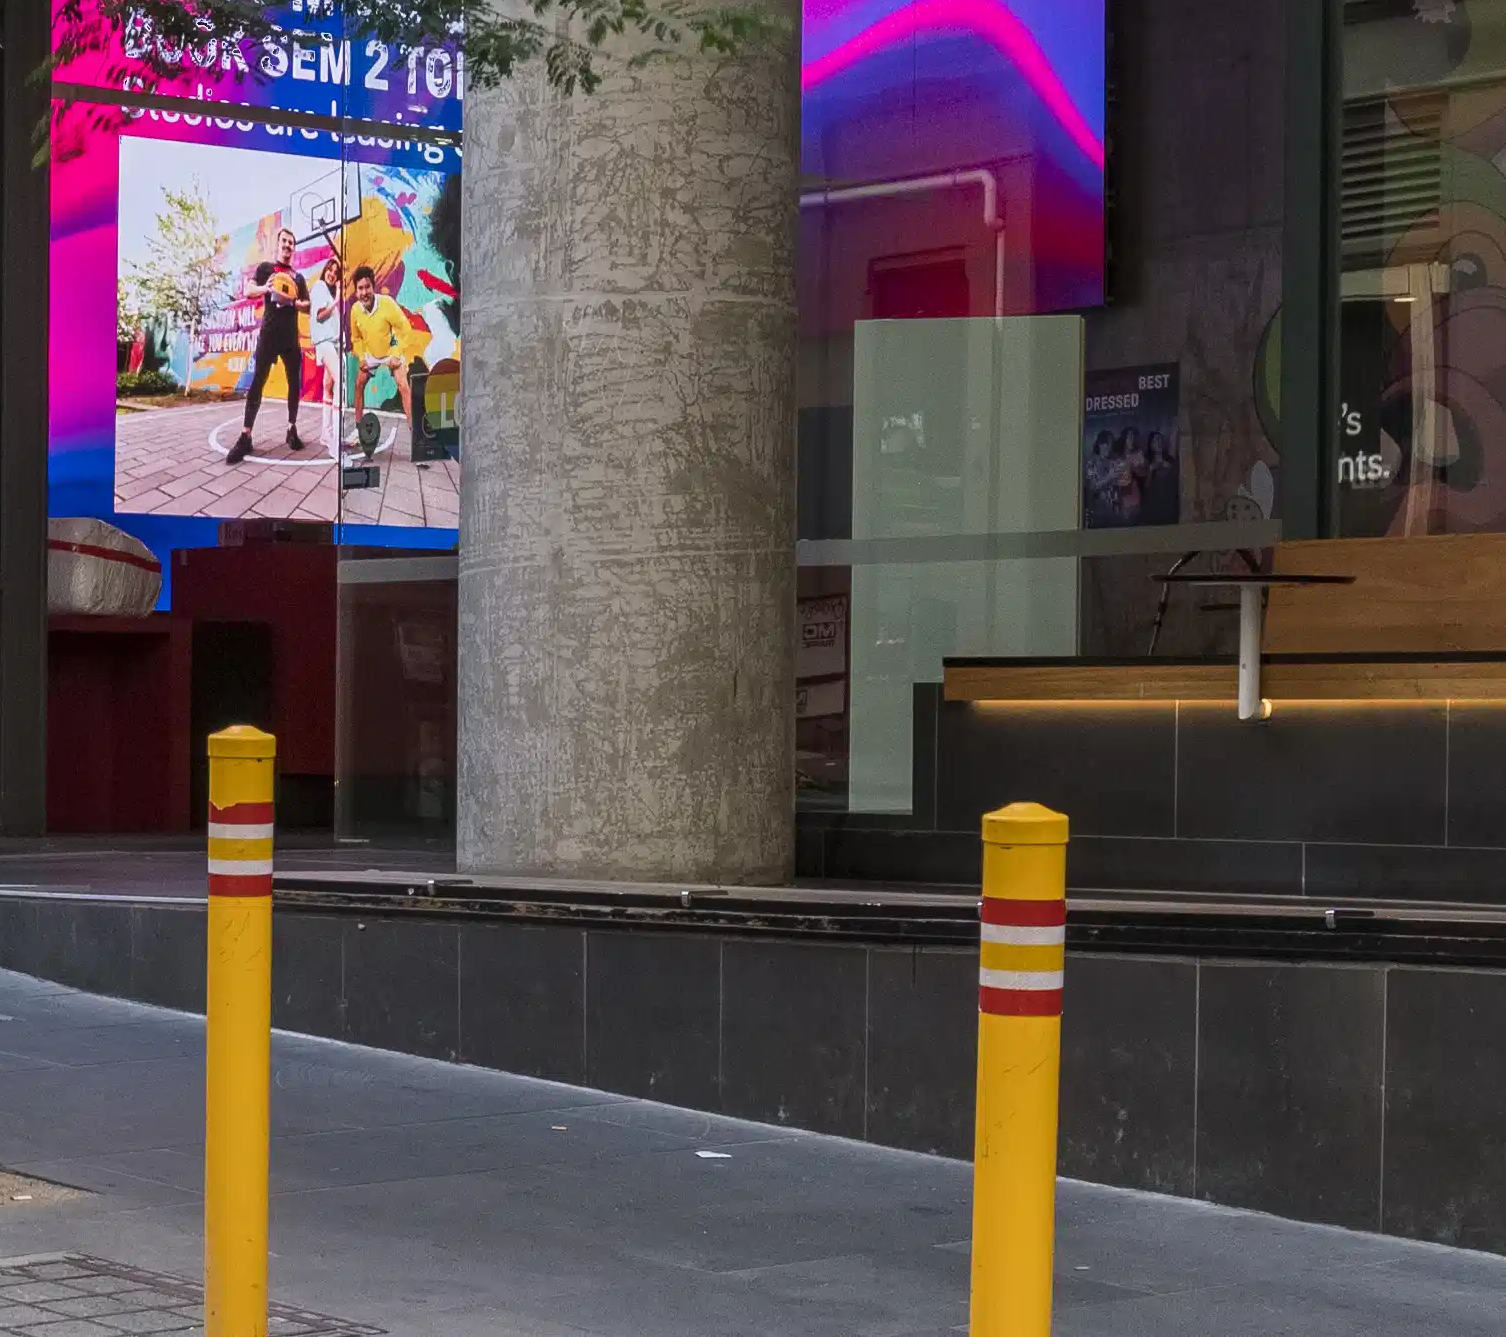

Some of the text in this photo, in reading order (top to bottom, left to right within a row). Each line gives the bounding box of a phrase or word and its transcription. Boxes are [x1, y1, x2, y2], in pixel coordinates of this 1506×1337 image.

[260, 25, 351, 86] SEM
[364, 39, 389, 91] 2
[1138, 374, 1171, 390] BEST
[1086, 393, 1140, 412] DRESSED
